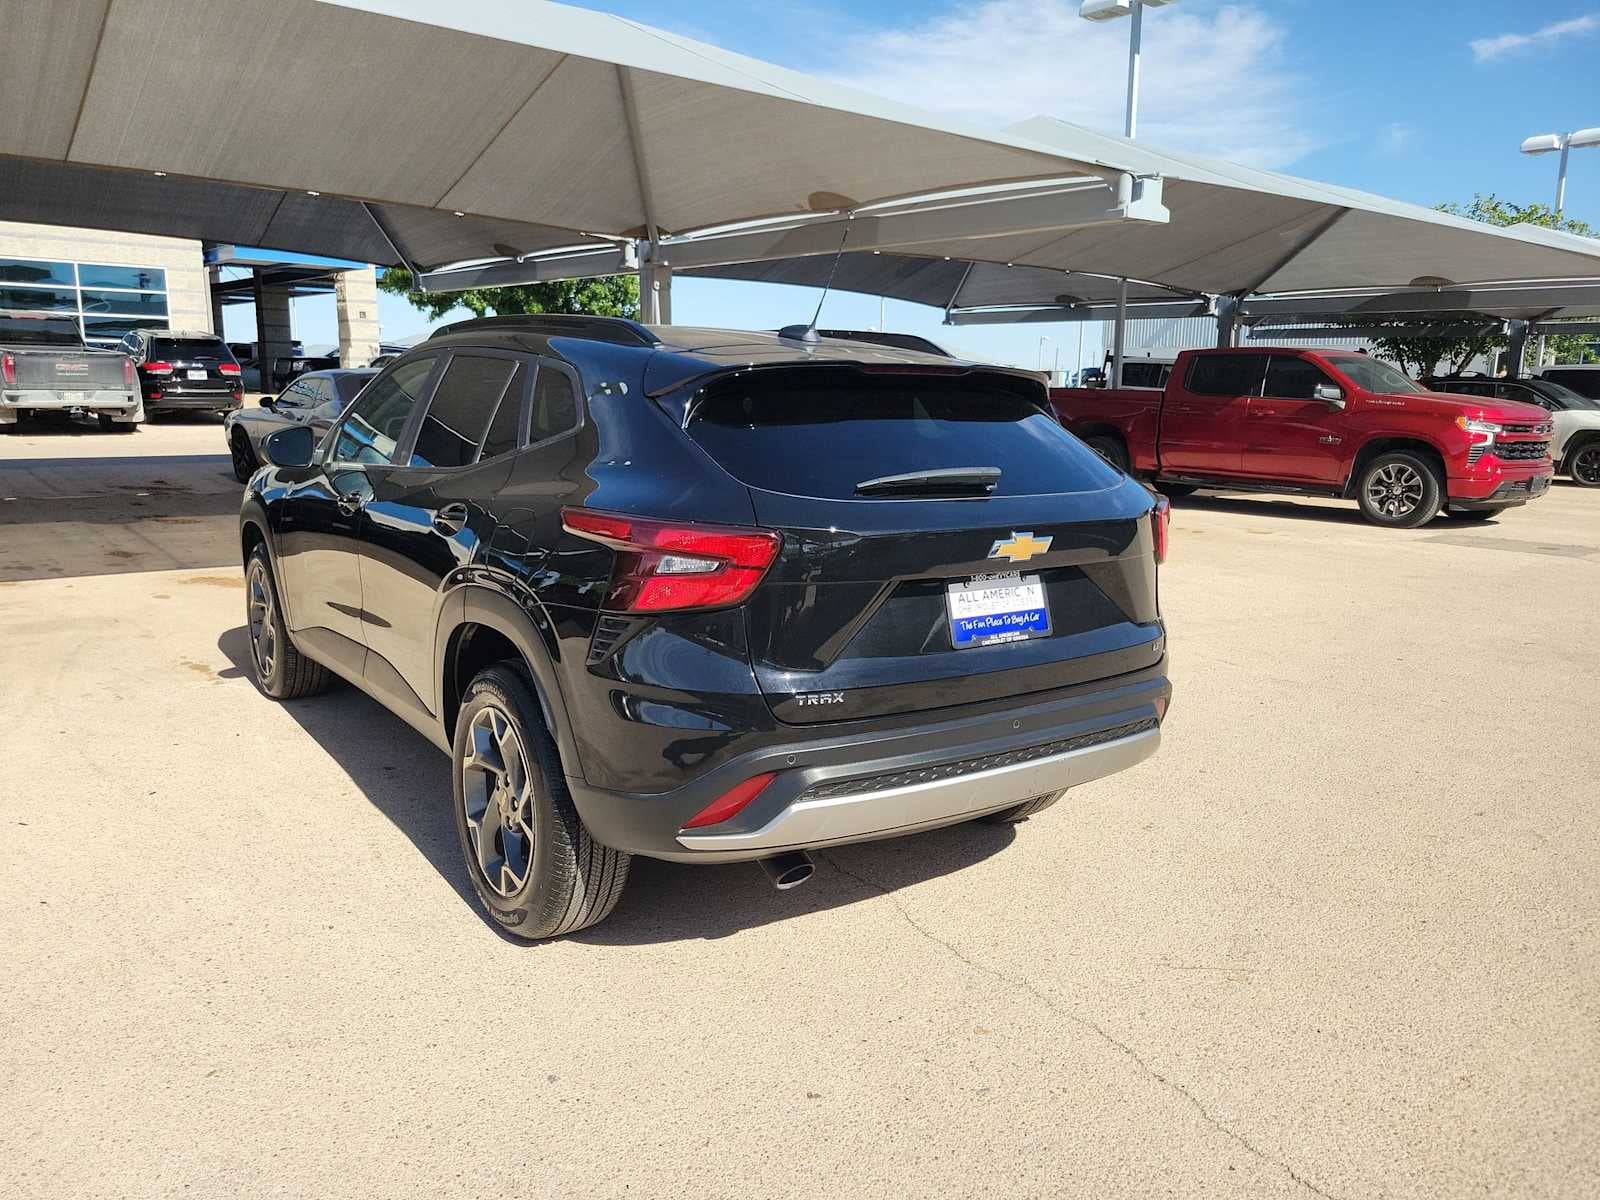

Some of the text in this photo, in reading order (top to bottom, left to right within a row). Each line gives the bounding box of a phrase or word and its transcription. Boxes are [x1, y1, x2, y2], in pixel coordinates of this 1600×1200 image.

[958, 586, 1035, 603] ALL AMERICN
[960, 620, 973, 631] The
[986, 616, 1003, 628] Place
[1003, 615, 1011, 625] To
[1023, 613, 1030, 623] A
[795, 692, 845, 706] TRAX
